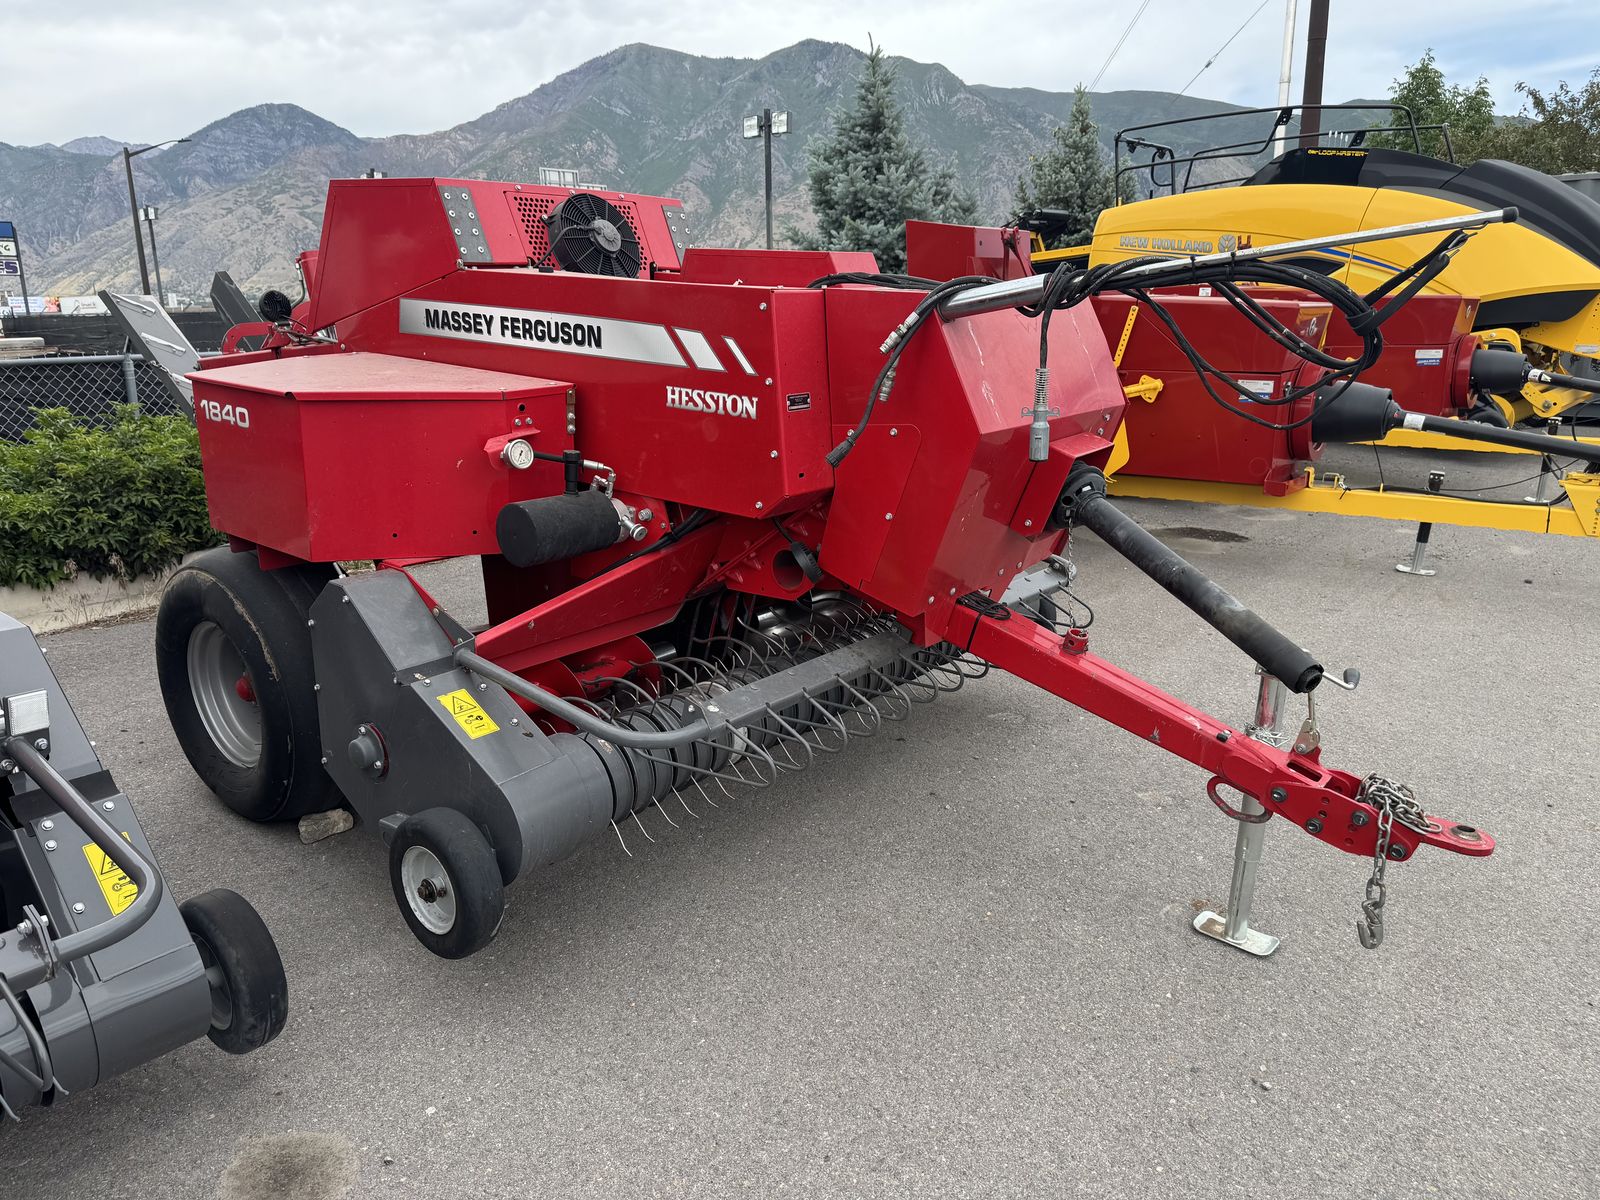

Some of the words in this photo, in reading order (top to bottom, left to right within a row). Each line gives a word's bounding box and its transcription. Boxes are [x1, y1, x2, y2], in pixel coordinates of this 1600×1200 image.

[1119, 235, 1149, 249] NEW
[1151, 237, 1213, 253] HOLLAND
[425, 308, 495, 336] MASSEY
[499, 315, 603, 349] FERGUSON
[200, 399, 250, 428] 1840
[665, 385, 759, 420] HESSTON
